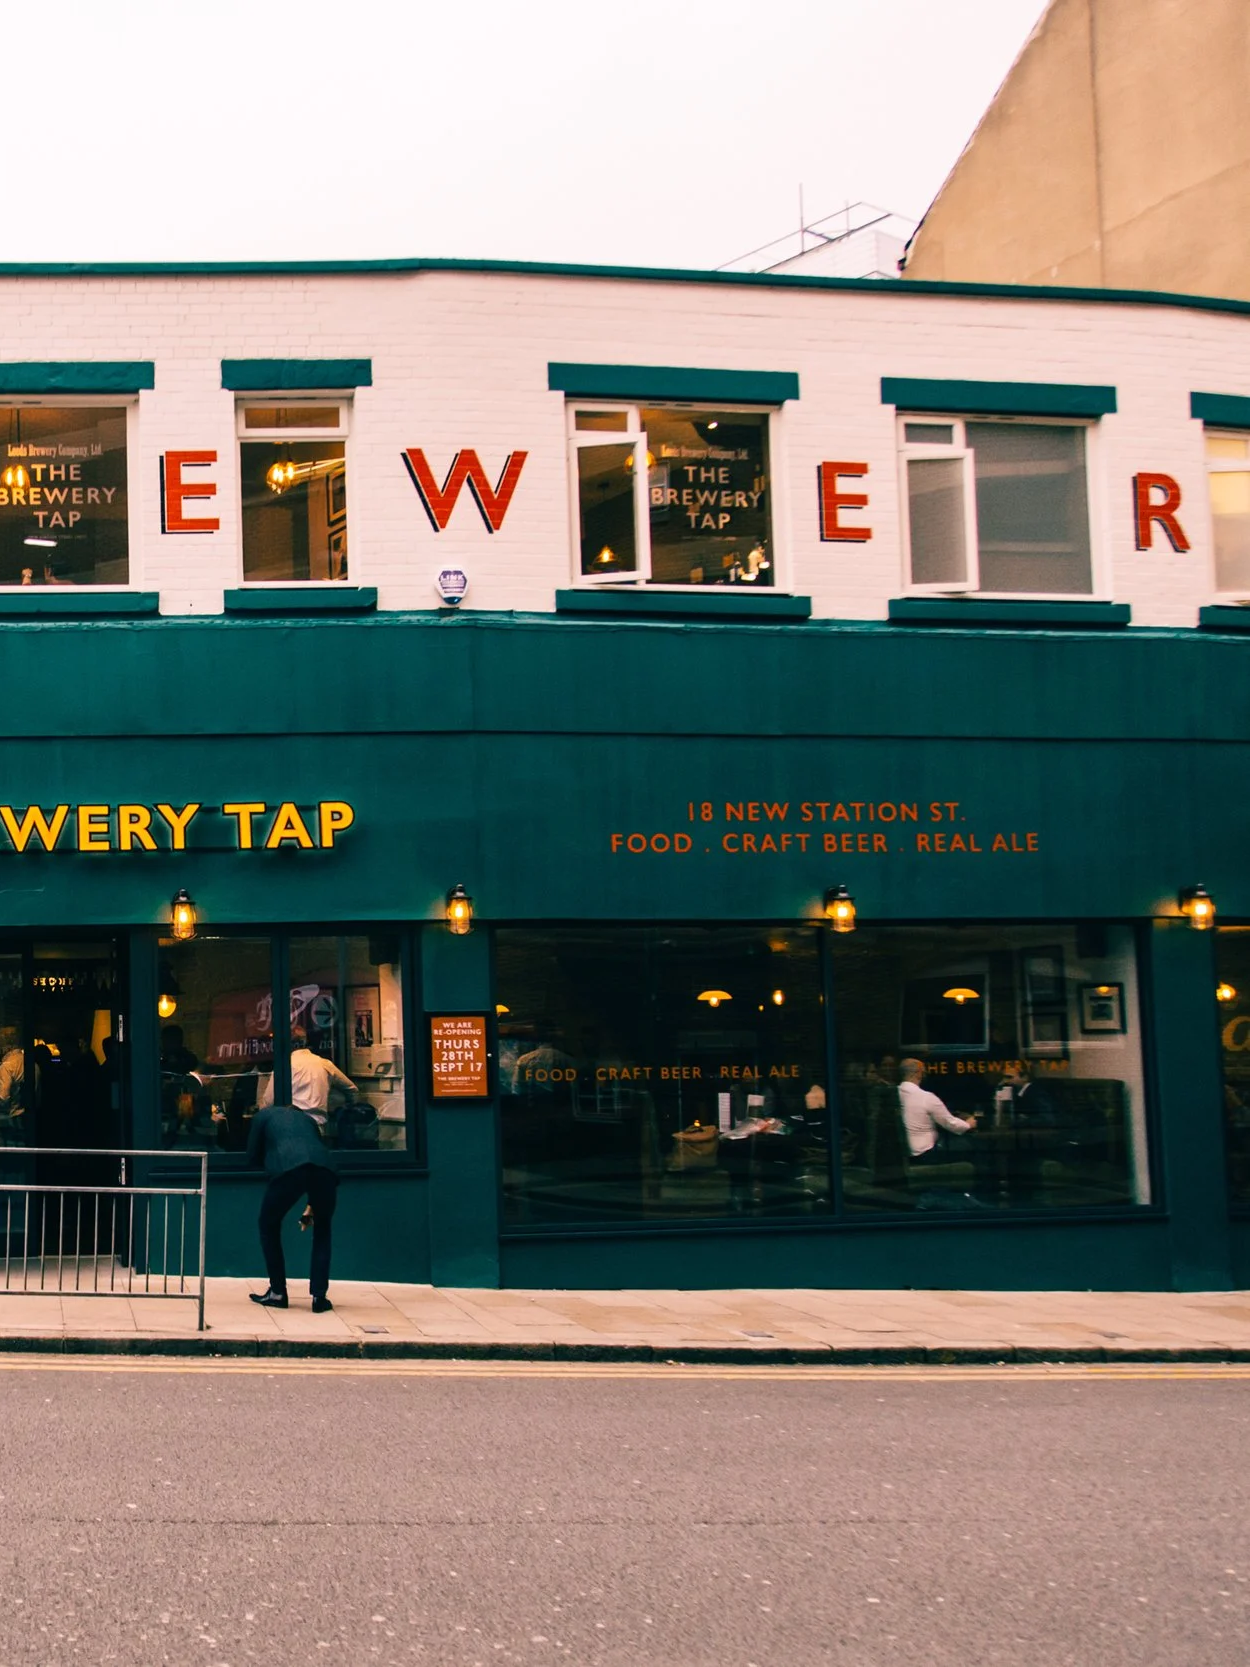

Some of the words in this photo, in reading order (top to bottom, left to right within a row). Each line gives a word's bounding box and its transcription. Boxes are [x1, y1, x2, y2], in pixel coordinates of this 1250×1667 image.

[29, 443, 57, 458] Brewery
[31, 463, 81, 482] THE
[683, 465, 730, 484] THE
[651, 487, 762, 508] BREWERY
[33, 511, 81, 528] TAP
[686, 512, 731, 529] TAP
[688, 802, 713, 821] 18
[725, 802, 789, 821] NEW
[801, 802, 918, 822] STATION
[929, 802, 966, 822] ST.
[222, 801, 355, 850] TAP
[611, 833, 693, 853] FOOD
[722, 833, 811, 853] CRAFT
[823, 833, 888, 853] BEER
[916, 832, 982, 852] REAL
[992, 832, 1039, 852] ALE
[434, 1039, 480, 1049] THURS
[442, 1051, 474, 1060] 28TH
[433, 1062, 464, 1072] SEPT
[470, 1062, 483, 1072] 17
[525, 1067, 577, 1081] FOOD
[596, 1067, 653, 1081] CRAFT
[661, 1066, 702, 1080] BEER
[720, 1065, 762, 1079] REAL
[769, 1065, 800, 1078] ALE
[956, 1060, 1032, 1074] BREWERY
[1039, 1060, 1069, 1072] TAP
